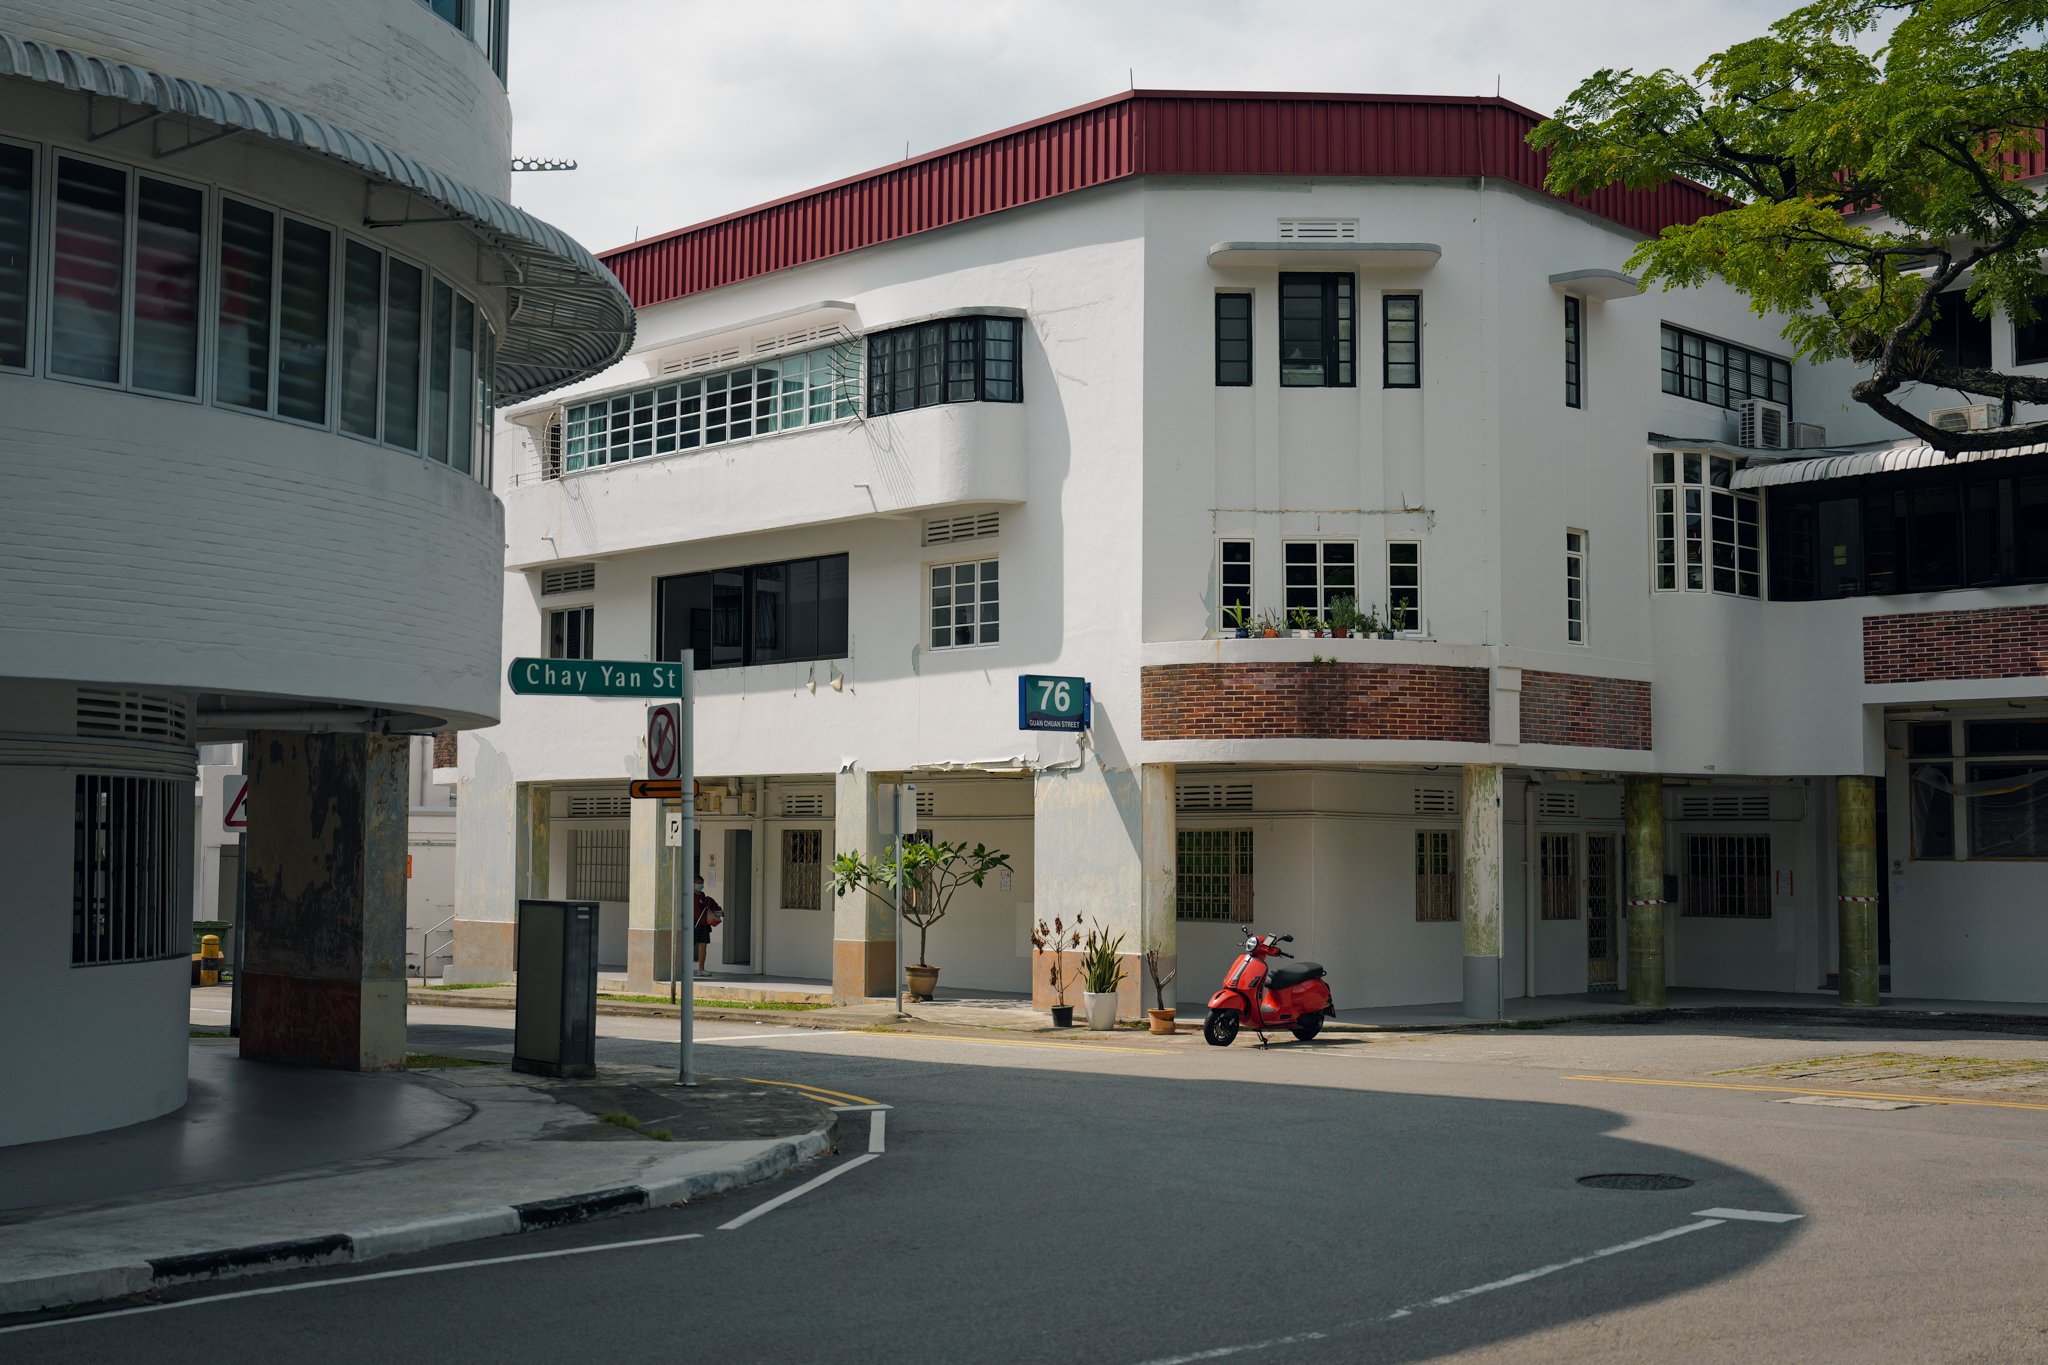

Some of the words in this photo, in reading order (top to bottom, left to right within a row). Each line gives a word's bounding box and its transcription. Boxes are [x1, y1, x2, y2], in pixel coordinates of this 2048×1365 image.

[526, 663, 587, 691] Chay
[601, 666, 641, 687] Yan
[652, 667, 676, 688] St
[1038, 680, 1071, 712] 76
[1029, 719, 1044, 727] GUAN
[1044, 720, 1061, 728] CHUAN
